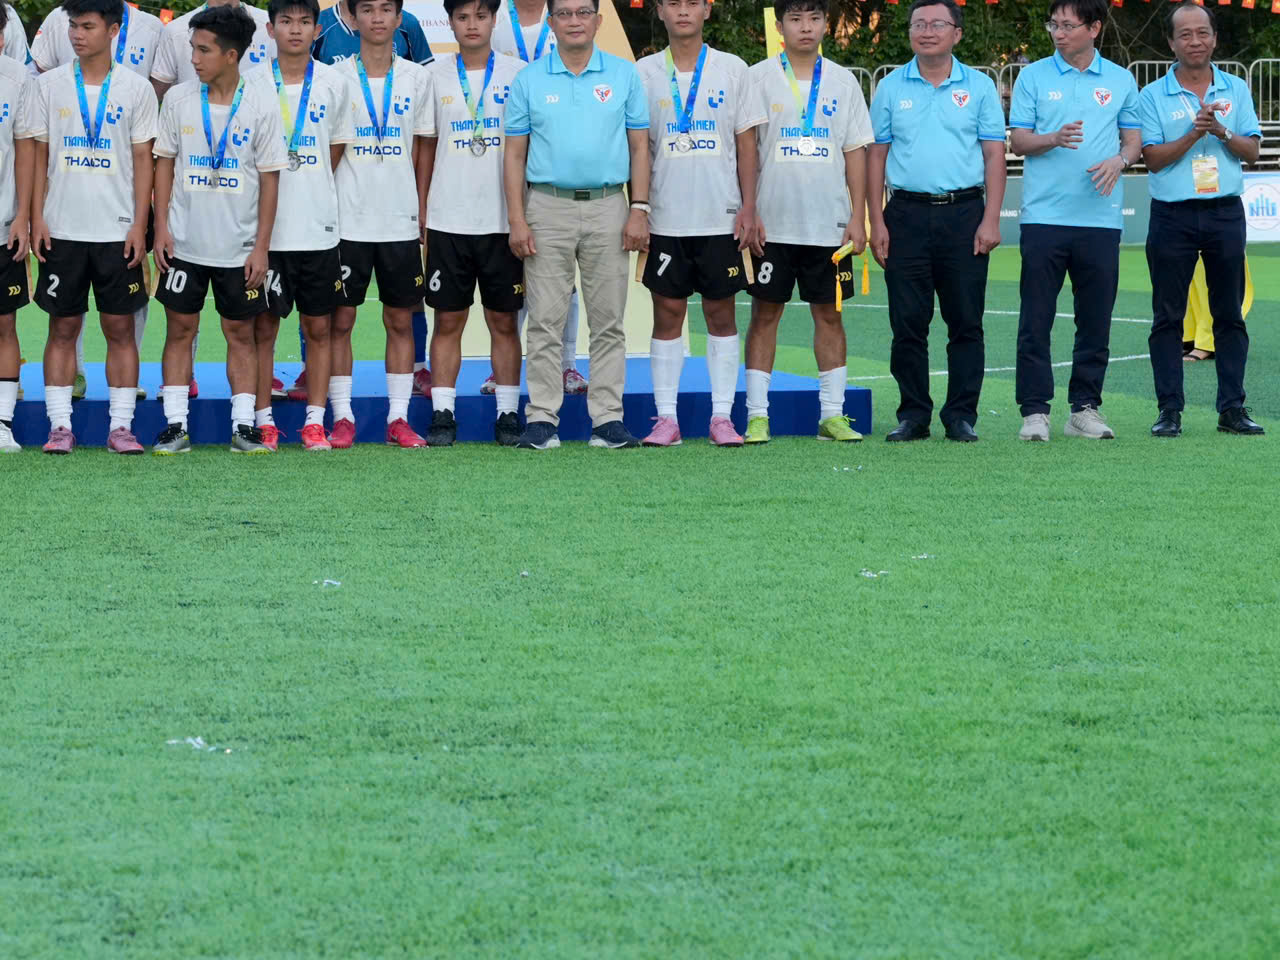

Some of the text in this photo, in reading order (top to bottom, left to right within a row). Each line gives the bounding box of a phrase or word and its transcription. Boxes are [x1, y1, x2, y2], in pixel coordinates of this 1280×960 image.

[353, 146, 402, 156] THACO
[657, 252, 672, 277] 7
[758, 261, 773, 284] 8
[47, 273, 60, 298] 2
[165, 267, 187, 294] 10
[265, 269, 282, 296] 14
[429, 269, 441, 292] 6
